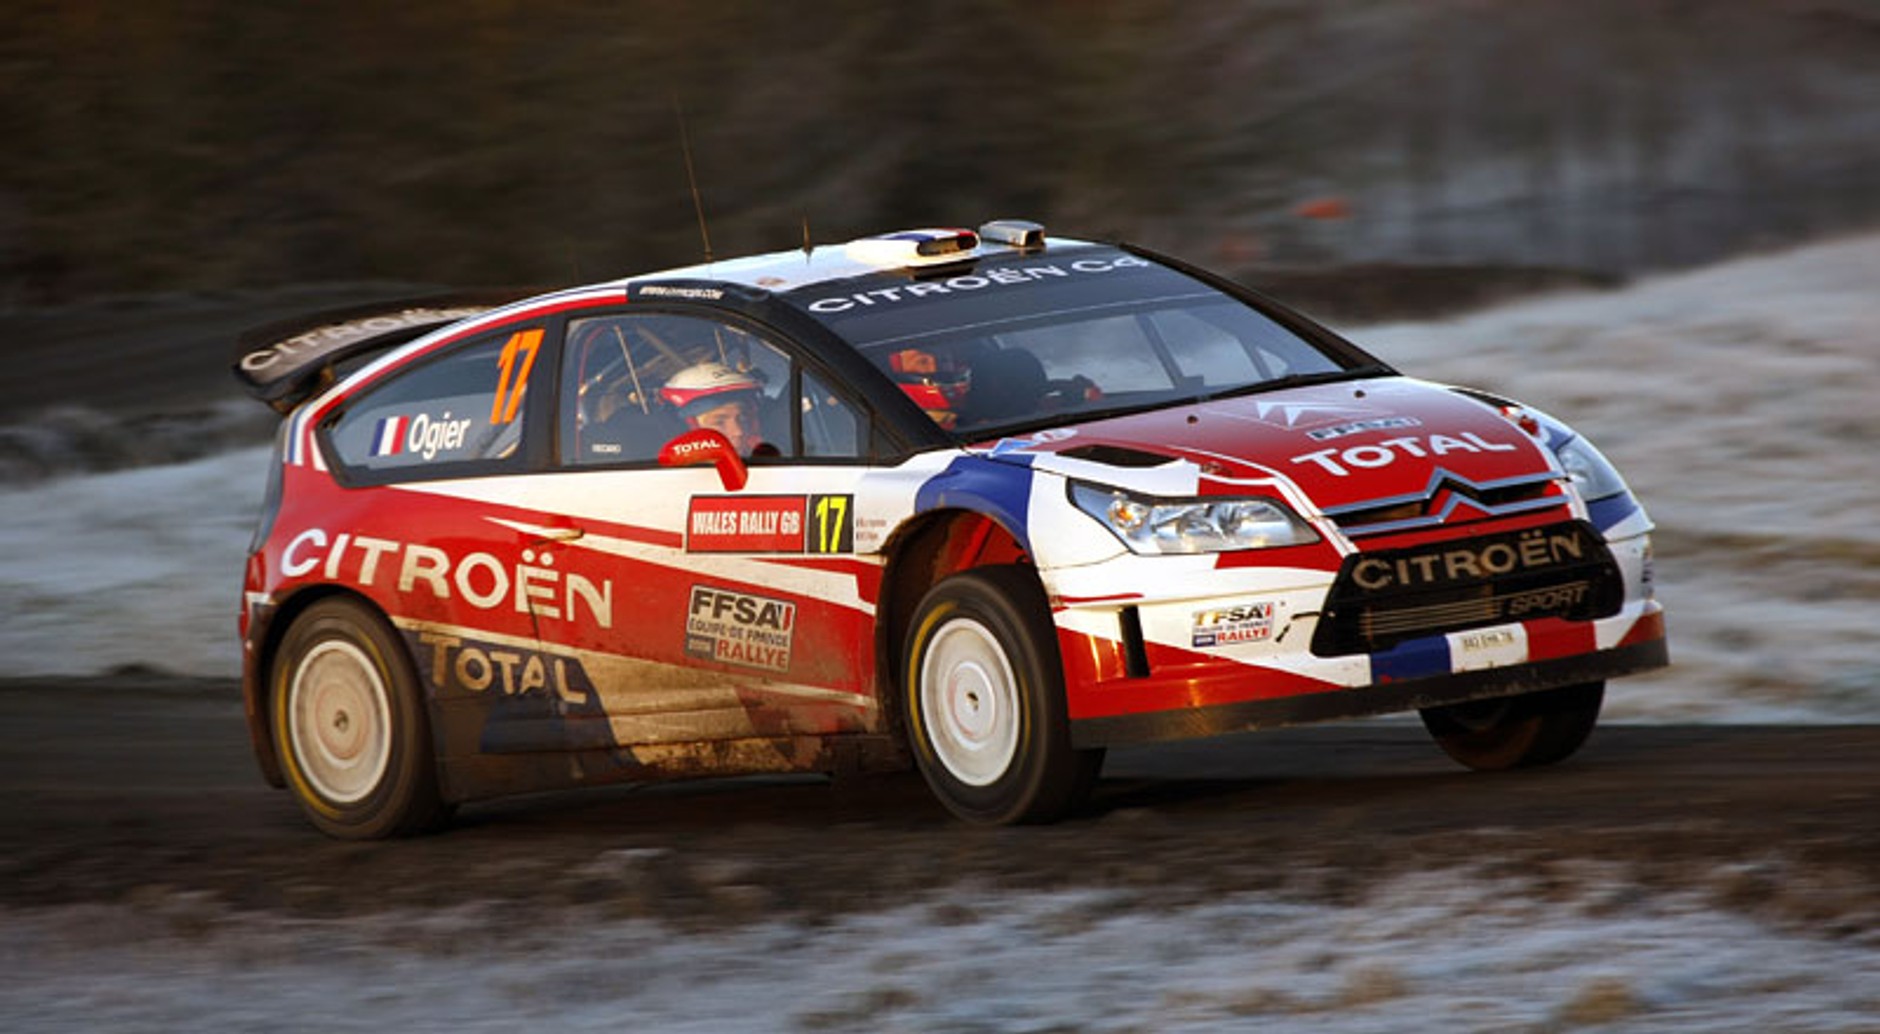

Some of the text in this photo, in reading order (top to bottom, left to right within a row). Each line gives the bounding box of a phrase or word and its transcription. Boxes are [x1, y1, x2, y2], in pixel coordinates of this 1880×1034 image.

[808, 266, 1068, 312] CITROËN
[490, 328, 546, 425] 17
[408, 411, 472, 460] Ogier
[672, 439, 721, 455] TOTAL
[1290, 432, 1518, 476] TOTAL
[692, 512, 737, 535] WALES
[739, 510, 779, 535] RALLY
[815, 496, 848, 553] 17
[280, 528, 613, 629] CITROËN
[1352, 528, 1582, 590] CITROËN
[691, 588, 780, 630] FFSA
[1508, 584, 1590, 616] SPORT
[419, 632, 586, 704] TOTAL
[716, 638, 788, 669] RALLYE
